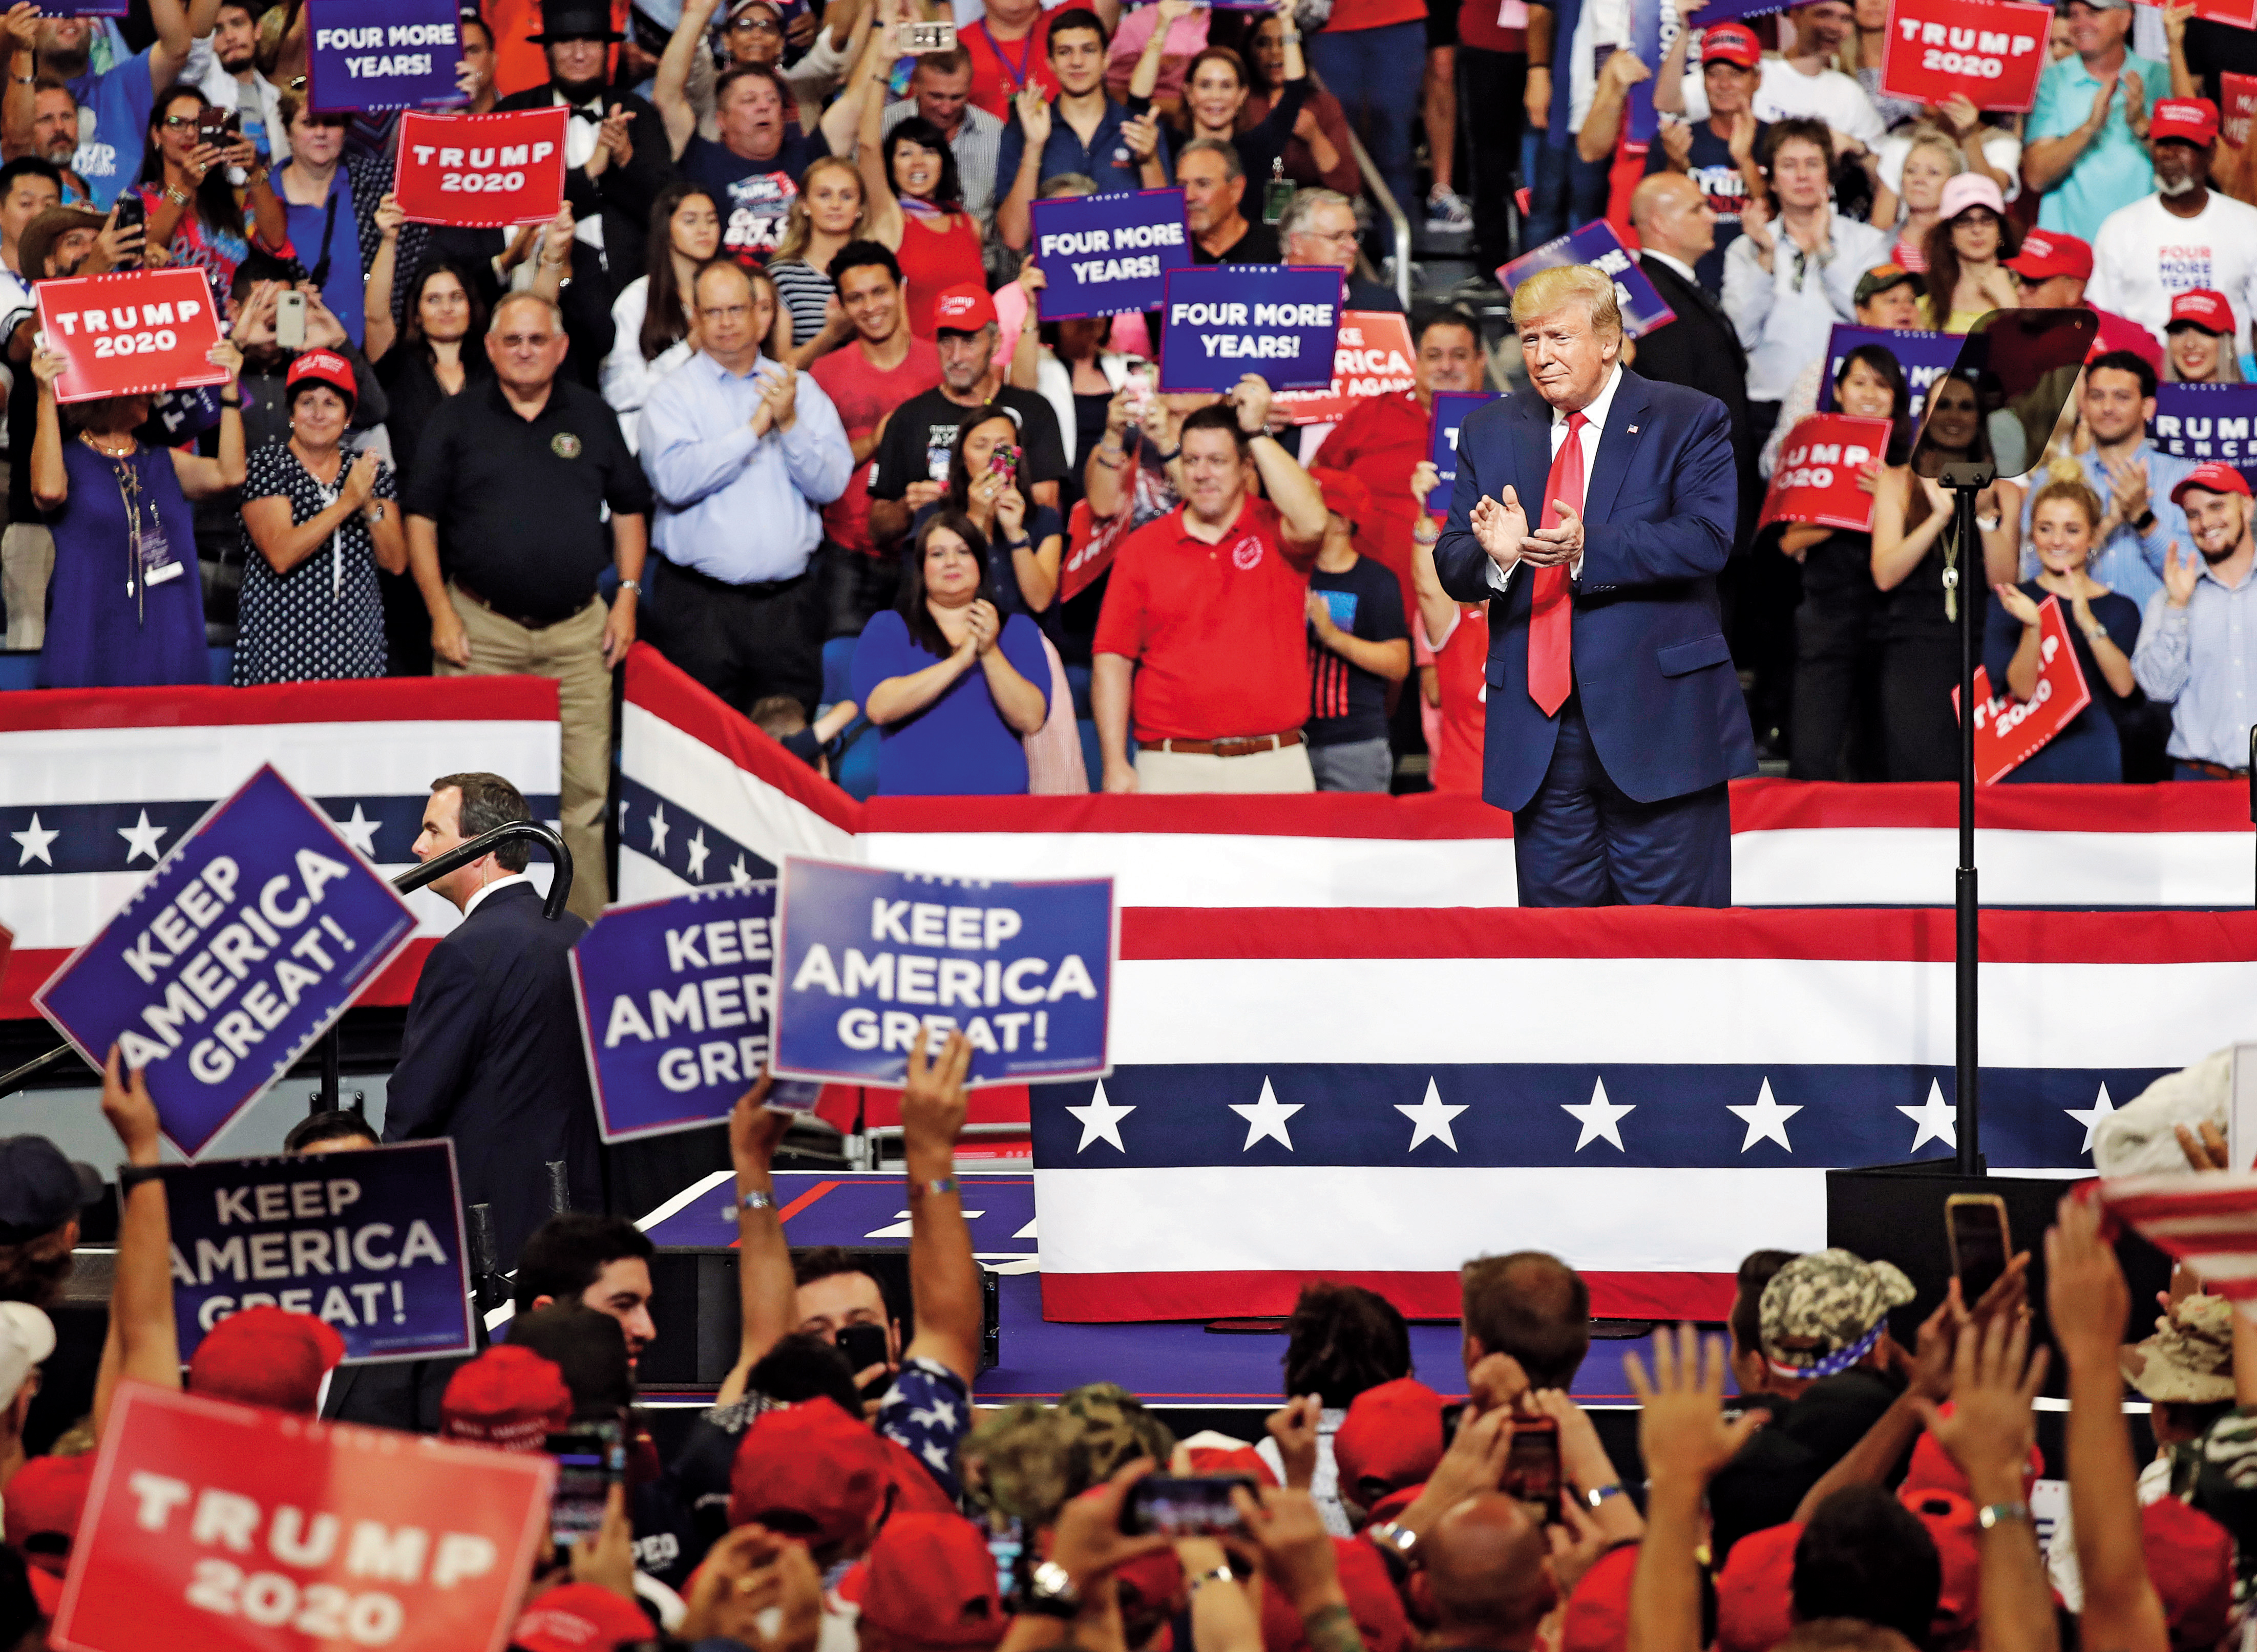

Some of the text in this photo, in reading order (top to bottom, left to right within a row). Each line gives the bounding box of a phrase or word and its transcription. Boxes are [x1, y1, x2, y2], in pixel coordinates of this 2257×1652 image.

[316, 24, 457, 51] FOUR MORE
[1898, 17, 2036, 56] TRUMP
[345, 54, 432, 78] YEARS!
[1922, 49, 2003, 79] 2020
[412, 141, 554, 168] TRUMP
[440, 171, 525, 193] 2020
[1041, 222, 1185, 257] FOUR MORE
[1072, 255, 1161, 284] YEARS!
[56, 300, 200, 335] TRUMP
[1171, 303, 1334, 327] FOUR MORE
[94, 329, 177, 358] 2020
[1200, 334, 1301, 358] YEARS!
[1334, 349, 1414, 375] RICA
[2156, 415, 2257, 440] RUM
[1786, 443, 1870, 468] UMP
[122, 855, 240, 984] KEEP
[871, 897, 1023, 950] KEEP
[118, 848, 351, 1070] AMERICA
[792, 943, 1098, 1008] AMERICA
[188, 915, 356, 1085] GREAT!
[604, 973, 773, 1049] AMER
[836, 1007, 1049, 1055] GREAT!
[658, 1034, 768, 1093] GRE
[214, 1178, 362, 1226] KEEP
[129, 1469, 499, 1590] TRUMP
[185, 1556, 406, 1642] 2020
